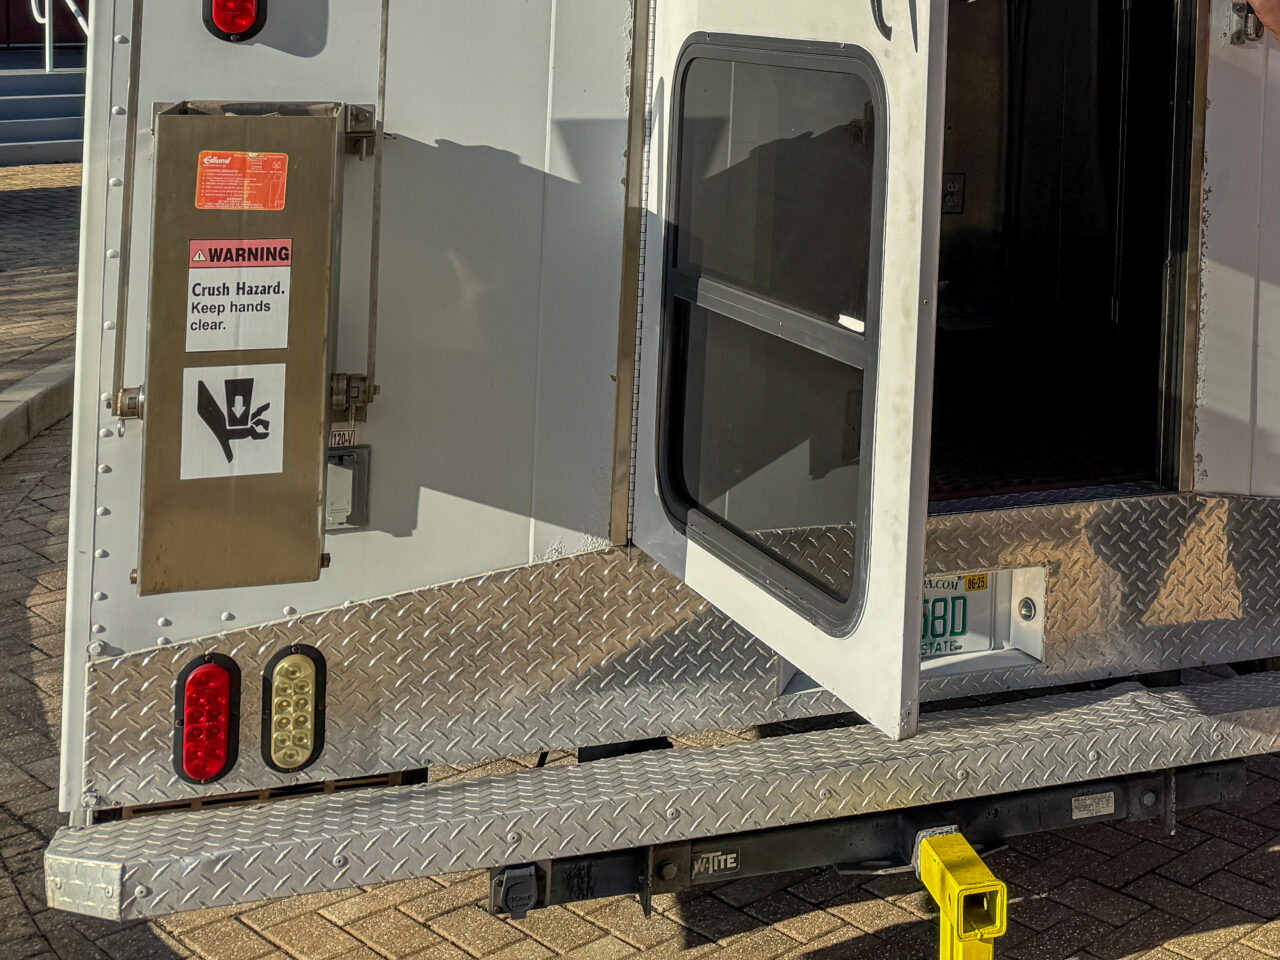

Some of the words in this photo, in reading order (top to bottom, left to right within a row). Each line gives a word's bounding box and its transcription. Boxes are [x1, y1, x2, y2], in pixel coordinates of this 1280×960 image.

[208, 246, 290, 262] WARNING
[192, 282, 229, 296] Crush
[236, 281, 285, 295] Hazard.
[191, 302, 225, 316] Keep
[230, 300, 271, 312] hands
[190, 319, 226, 330] clear.
[333, 431, 353, 446] 120-V
